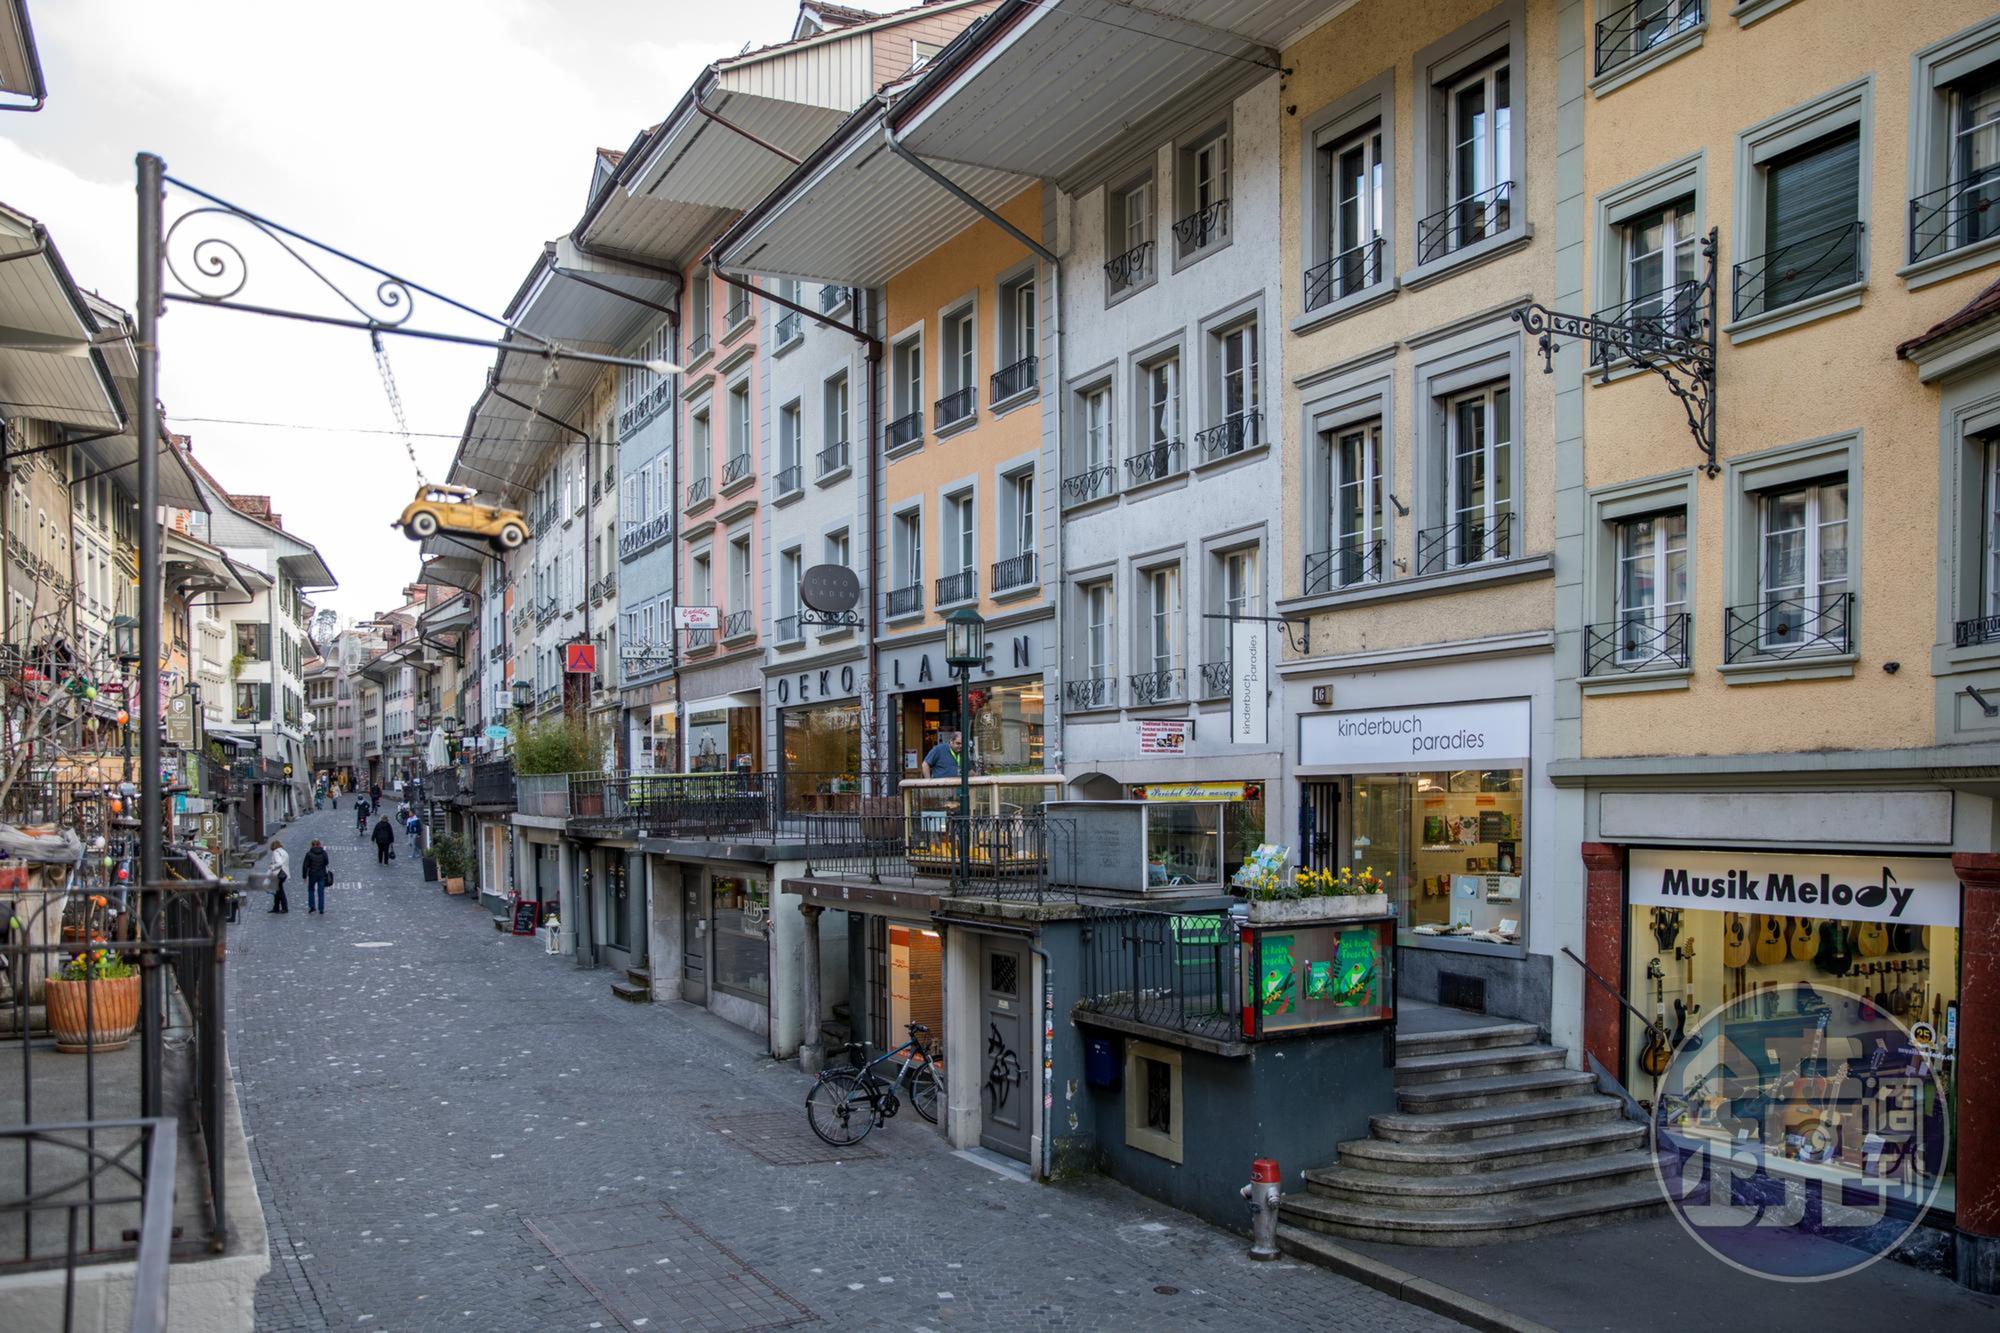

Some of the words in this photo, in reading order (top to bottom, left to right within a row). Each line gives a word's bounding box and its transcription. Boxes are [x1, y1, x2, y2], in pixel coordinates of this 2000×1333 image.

[809, 590, 856, 599] LADEN
[812, 578, 849, 587] OEKO
[690, 614, 703, 623] Bar
[1250, 634, 1258, 682] paradies
[778, 666, 854, 703] OEKO
[1242, 674, 1251, 736] kinderbuch
[1338, 714, 1422, 738] kinderbuch
[1412, 730, 1485, 755] paradies
[1661, 868, 1760, 901] Musik
[1765, 866, 1914, 917] Melody
